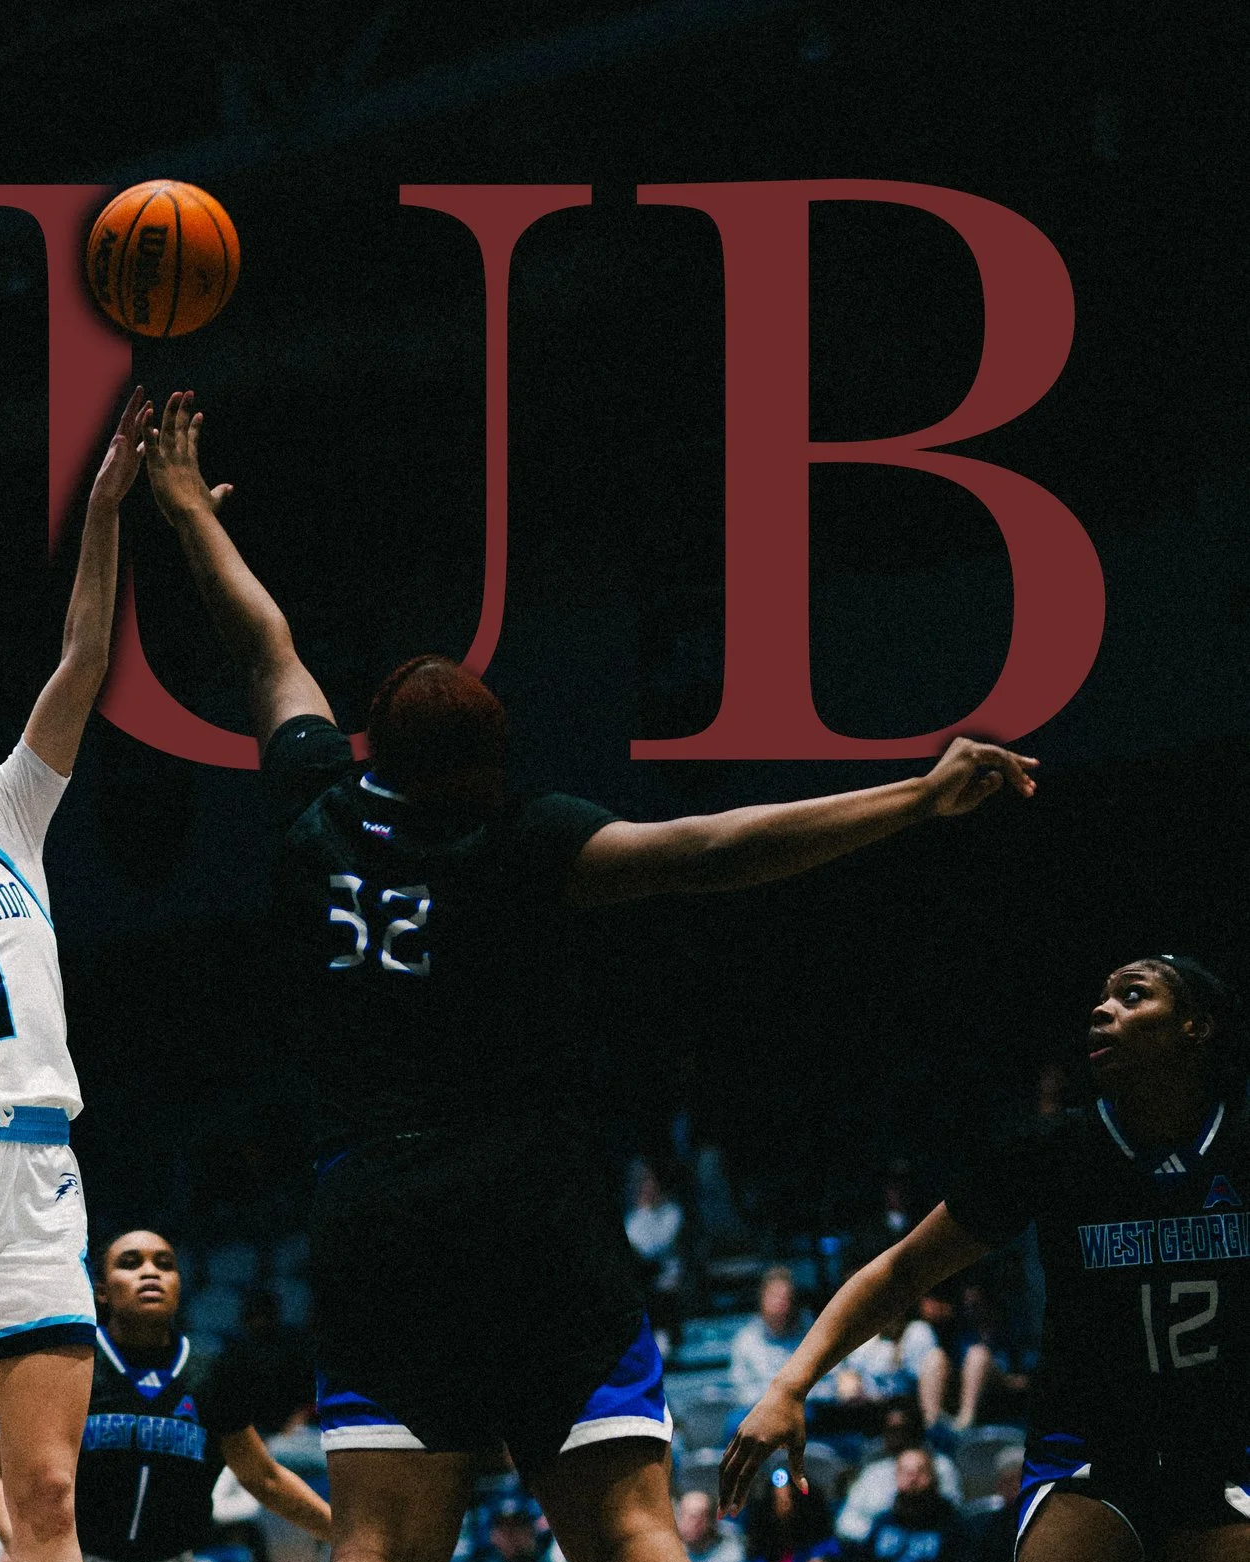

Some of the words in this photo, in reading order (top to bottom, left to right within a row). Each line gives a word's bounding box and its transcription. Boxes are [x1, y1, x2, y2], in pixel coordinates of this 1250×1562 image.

[327, 871, 432, 977] 32
[1077, 1219, 1155, 1270] WEST
[1158, 1212, 1250, 1263] GEORGI
[1141, 1279, 1219, 1373] 12
